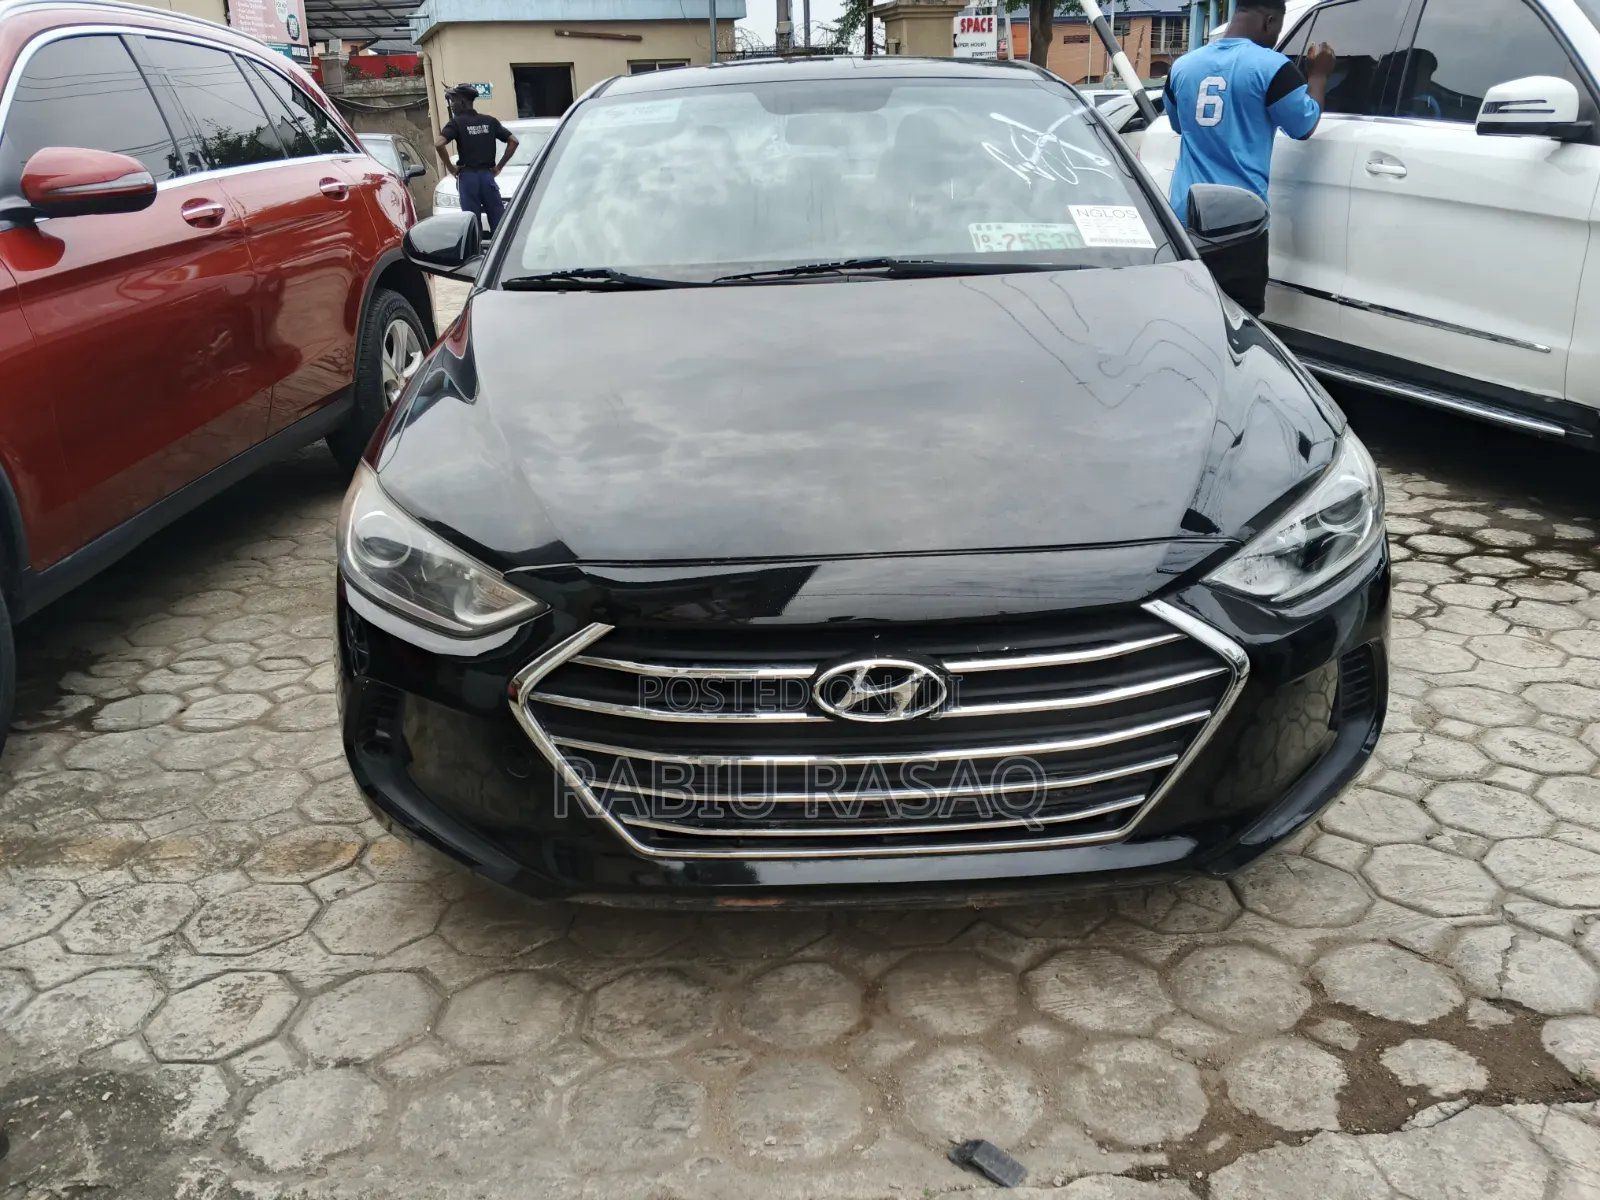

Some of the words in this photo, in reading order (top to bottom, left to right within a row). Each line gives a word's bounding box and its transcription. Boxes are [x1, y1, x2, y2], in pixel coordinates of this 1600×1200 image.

[960, 17, 993, 33] SPACE
[1195, 76, 1227, 127] 6
[1076, 208, 1138, 219] NGLOS
